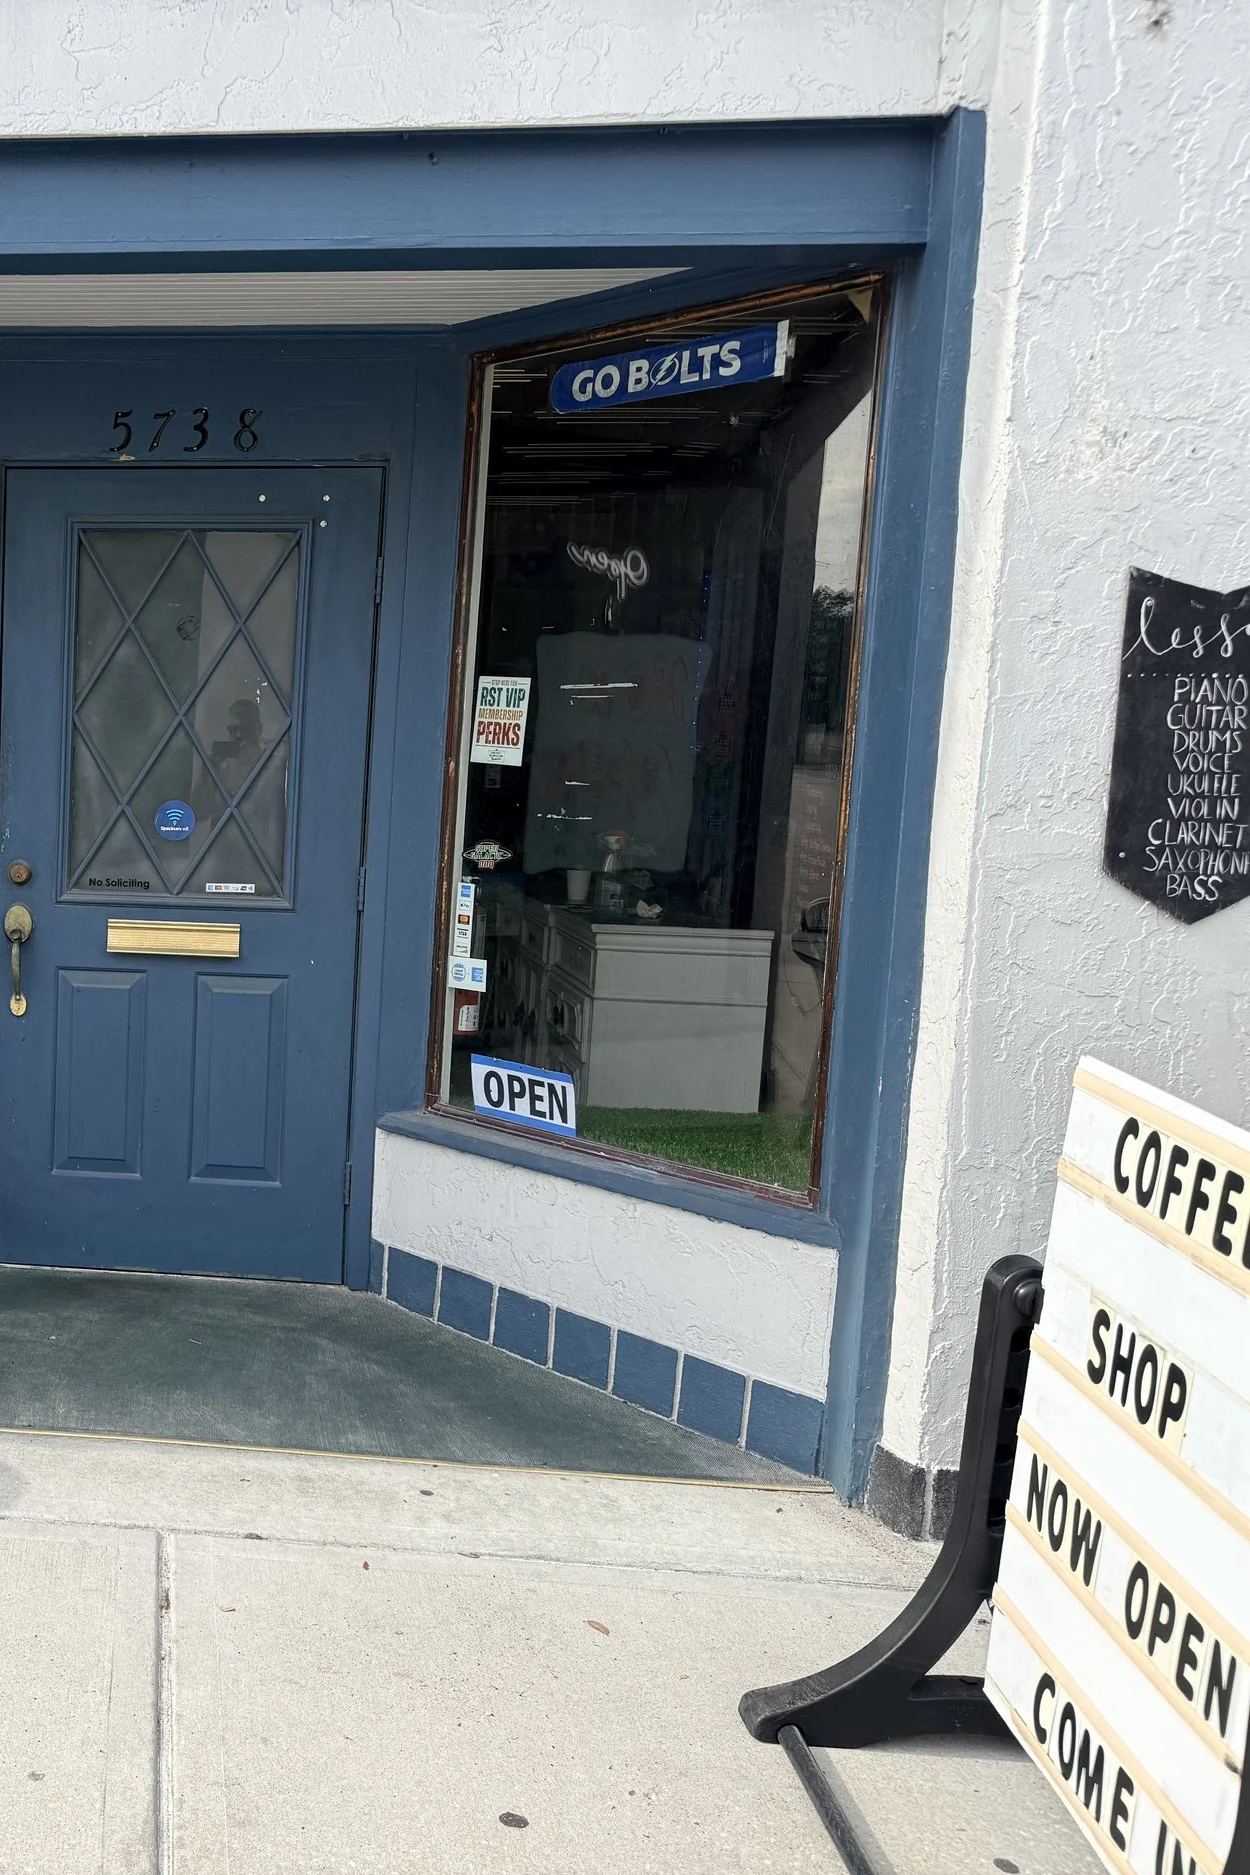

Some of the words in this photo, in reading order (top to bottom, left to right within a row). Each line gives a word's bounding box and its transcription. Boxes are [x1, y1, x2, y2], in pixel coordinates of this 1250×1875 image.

[571, 365, 620, 402] GO
[109, 407, 263, 452] 5738
[1122, 596, 1250, 660] less
[480, 687, 503, 707] RST
[505, 687, 526, 708] VIP
[1174, 677, 1248, 704] PIANO
[478, 708, 523, 721] MEMBERSHIP
[1167, 703, 1247, 729] GUITAR
[476, 721, 521, 746] PERKS
[1173, 730, 1242, 753] DRUMS
[1173, 753, 1234, 773] VOICE
[1167, 773, 1242, 796] UKULELE
[1167, 797, 1240, 820] VIOLIN
[1147, 818, 1249, 848] CLARINET
[89, 878, 102, 886] No
[105, 878, 150, 890] Soliciting
[1166, 873, 1223, 901] BASS
[483, 1070, 568, 1124] OPEN
[1087, 1308, 1187, 1439] SHOP
[1027, 1453, 1102, 1587] NOW
[1125, 1560, 1237, 1738] OPEN
[1033, 1672, 1135, 1852] COME
